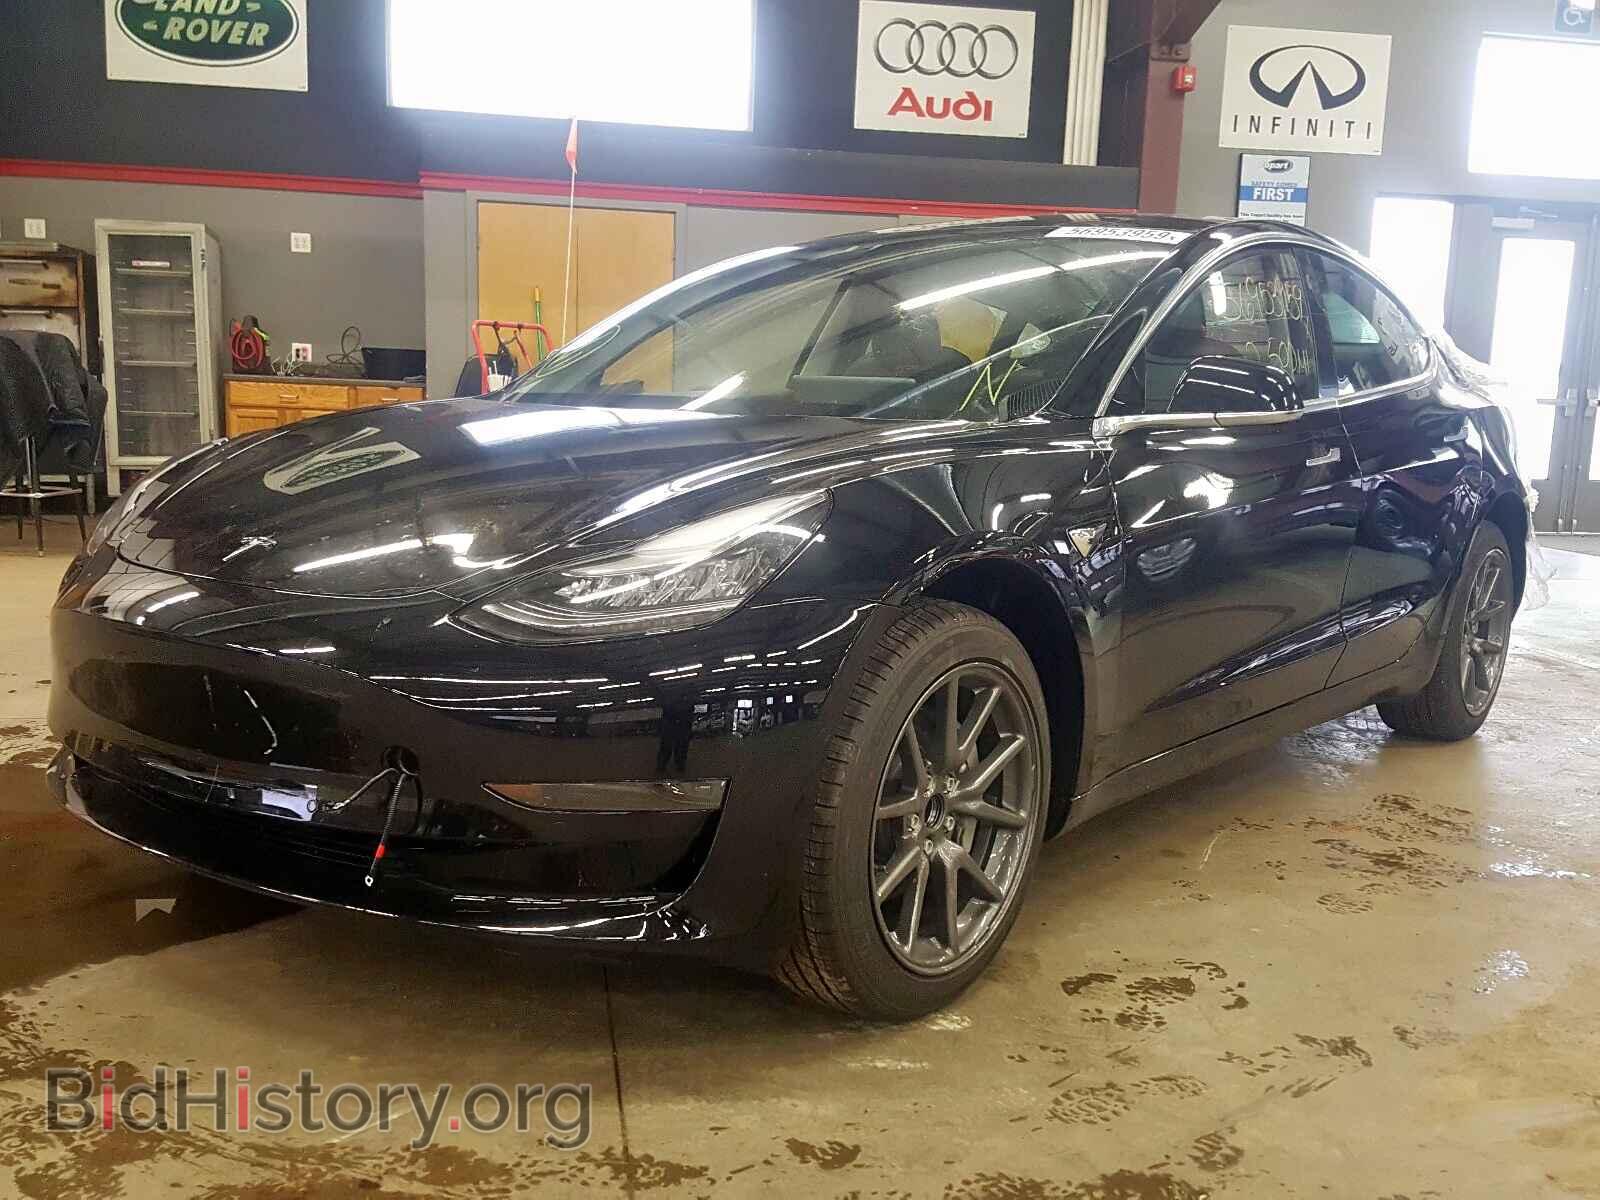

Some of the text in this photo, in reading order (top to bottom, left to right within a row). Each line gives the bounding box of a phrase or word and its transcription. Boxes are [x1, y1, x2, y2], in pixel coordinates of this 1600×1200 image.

[163, 17, 270, 46] ROVER
[887, 86, 994, 122] Audi
[1232, 114, 1372, 139] INFINITI
[1252, 187, 1295, 201] FIRST
